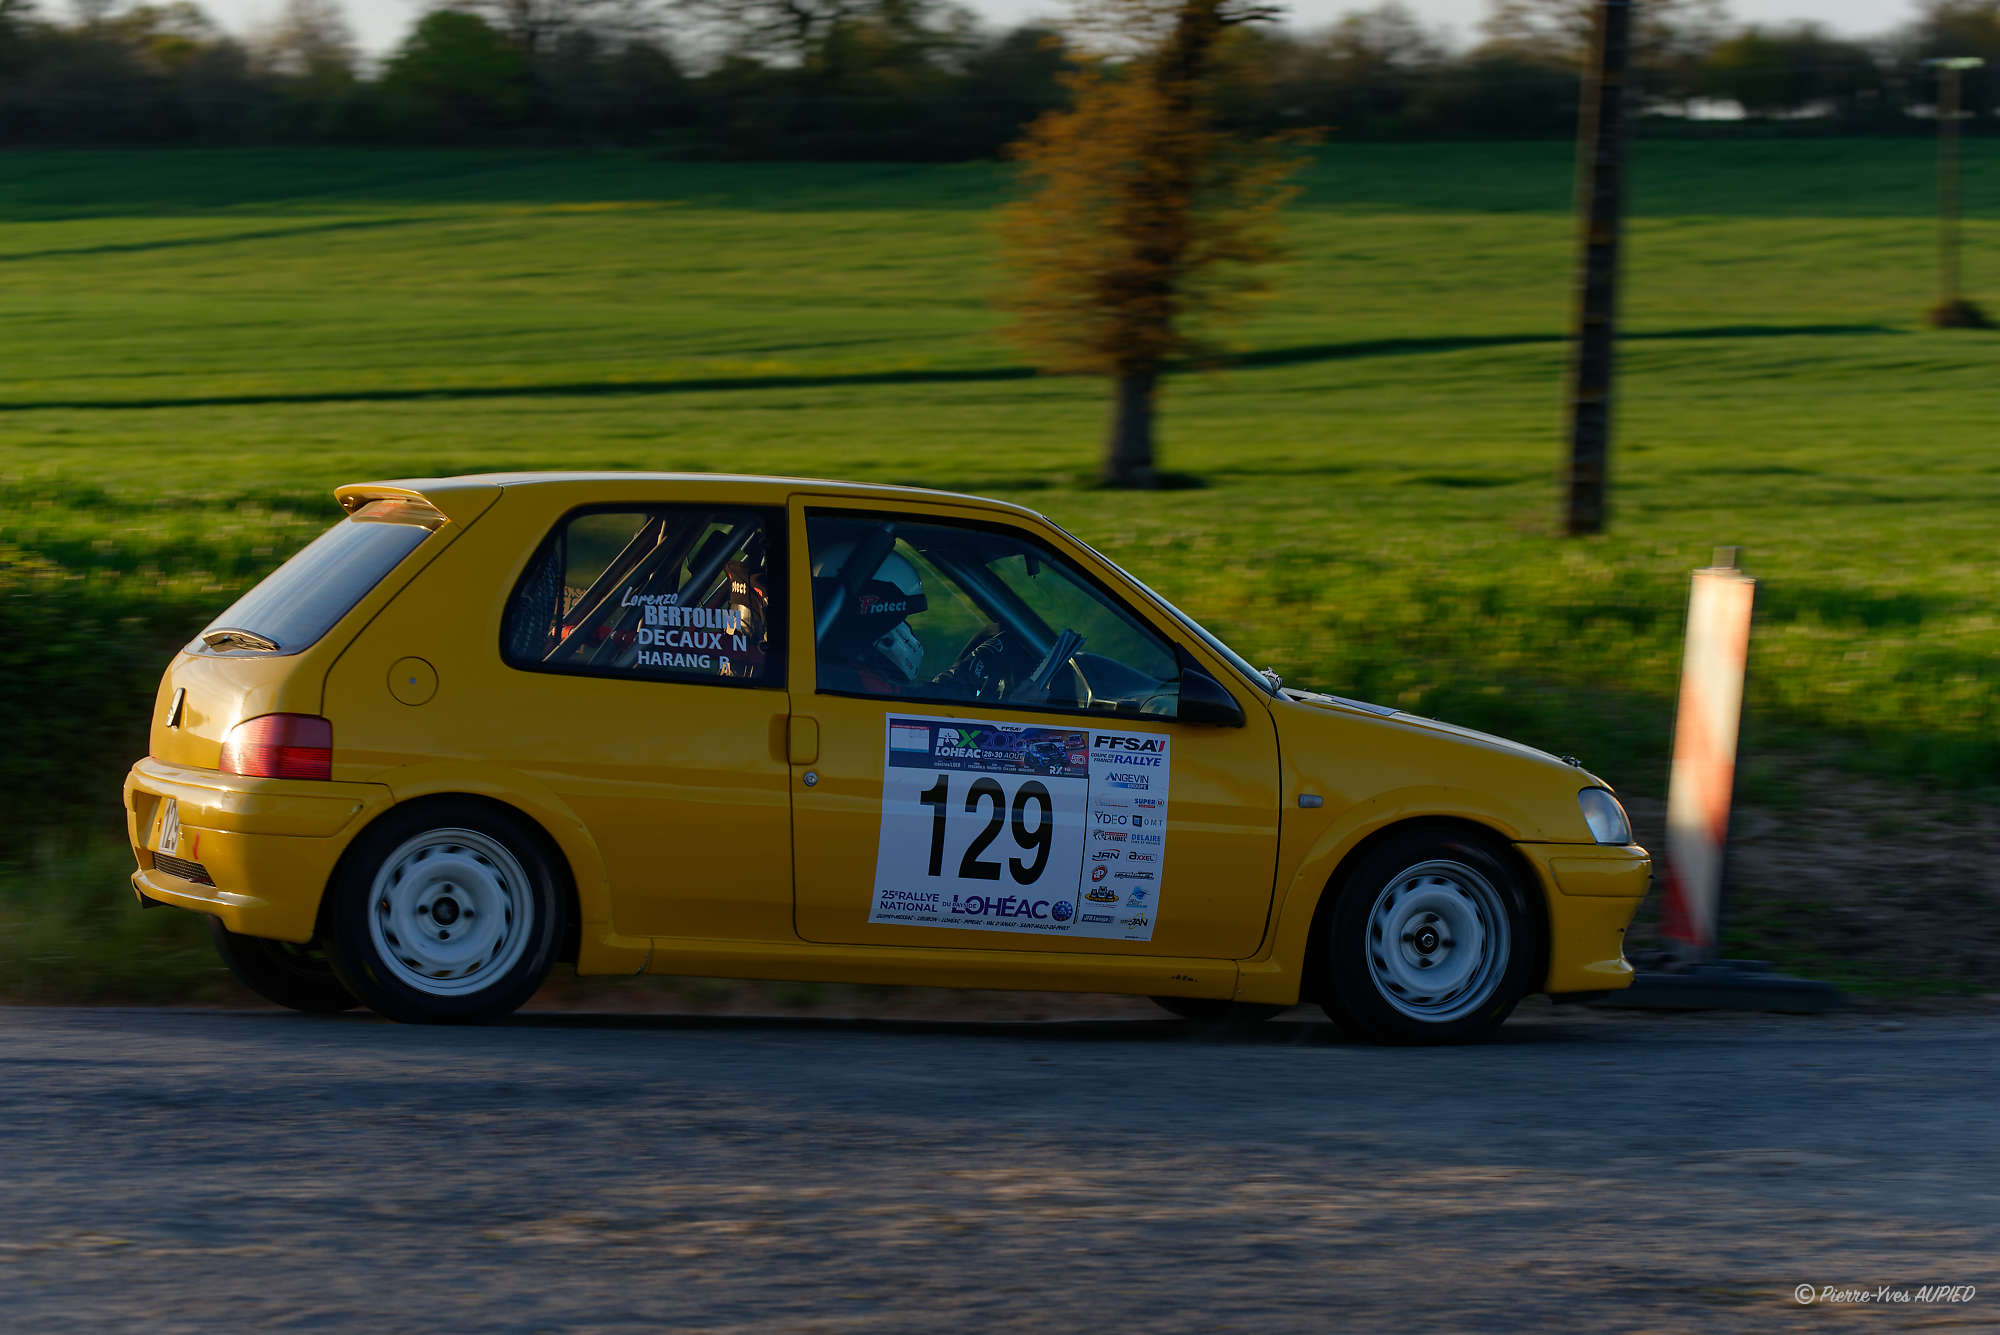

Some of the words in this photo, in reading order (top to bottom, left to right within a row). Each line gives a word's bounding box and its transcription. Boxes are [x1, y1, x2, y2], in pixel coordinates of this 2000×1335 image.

[621, 586, 679, 607] Lorenzo
[644, 605, 742, 630] BERTOLINI
[638, 628, 722, 650] DECAUX
[732, 634, 747, 653] N
[638, 650, 711, 669] HARANG
[935, 746, 981, 760] LOHEAC
[1093, 735, 1158, 752] FFSA
[1114, 754, 1162, 767] RALLYE
[1104, 771, 1150, 784] ANGEVIN
[920, 774, 1053, 886] 129
[879, 900, 938, 914] NATIONAL
[951, 893, 1050, 920] LOHÉAC
